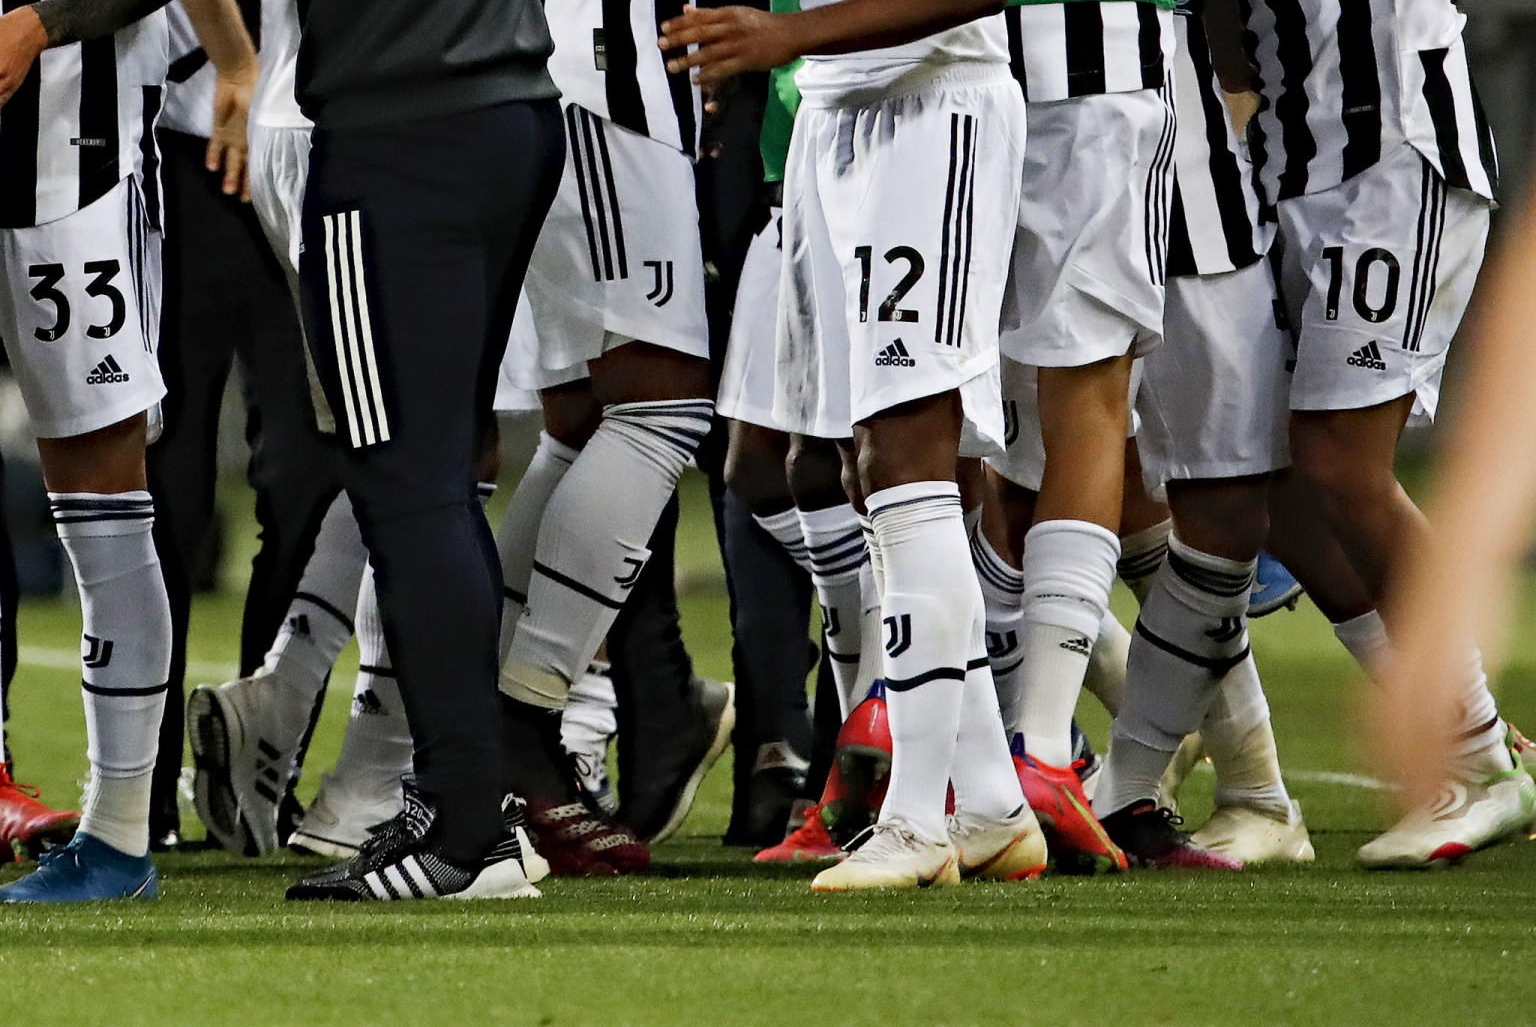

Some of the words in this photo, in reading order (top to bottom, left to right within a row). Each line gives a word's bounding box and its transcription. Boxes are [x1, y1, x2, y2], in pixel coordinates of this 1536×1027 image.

[28, 258, 127, 343] 33
[854, 245, 925, 323] 12
[1322, 245, 1400, 324] 10
[86, 372, 130, 386] adidas
[875, 355, 915, 368] adidas
[1347, 356, 1386, 371] adidas
